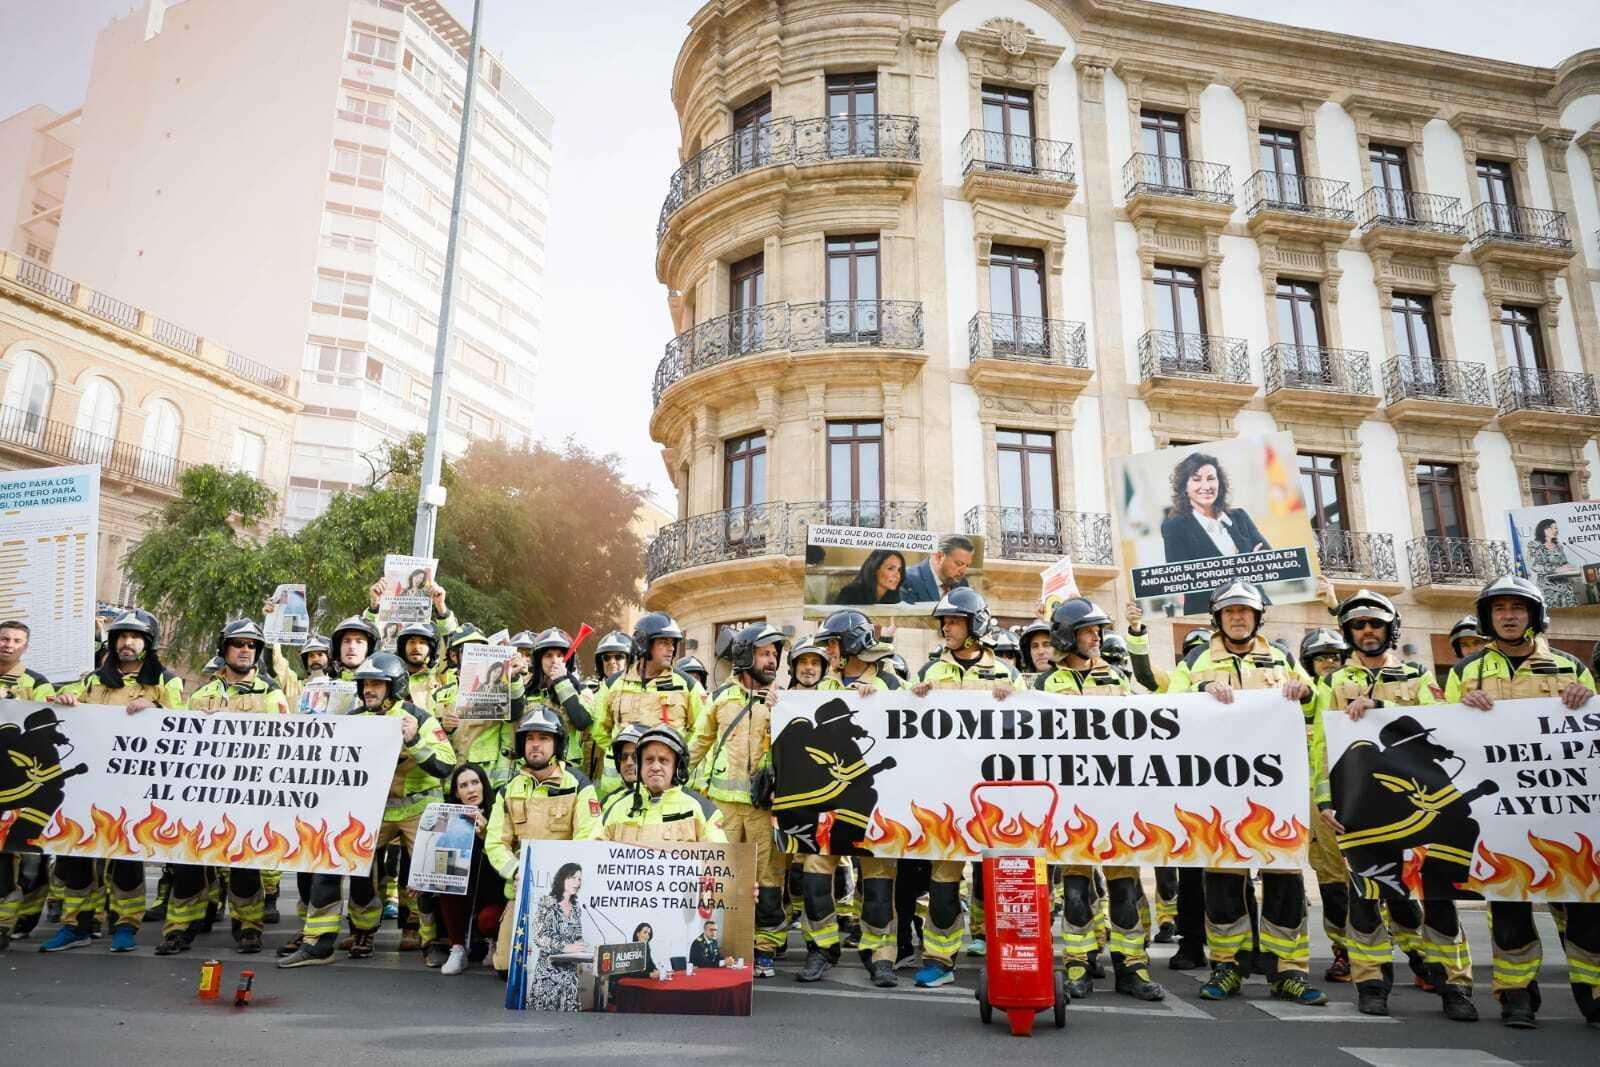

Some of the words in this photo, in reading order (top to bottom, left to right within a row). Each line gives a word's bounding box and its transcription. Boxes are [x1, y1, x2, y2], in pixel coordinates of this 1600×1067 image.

[24, 488, 50, 498] PERO
[52, 486, 77, 495] PARA
[29, 479, 54, 488] PARA
[56, 477, 74, 486] LOS
[14, 499, 39, 508] TOMA
[41, 495, 82, 505] MORENO
[886, 530, 906, 540] DIGO
[906, 542, 934, 550] LORCA
[1150, 565, 1182, 576] MEJOR
[1184, 560, 1220, 572] SUELDO
[1222, 558, 1236, 567] DE
[1237, 552, 1282, 565] ALCALDÍA
[1284, 550, 1297, 558] EN
[1141, 574, 1195, 587] ANDALUCÍA,
[1196, 568, 1235, 580] PORQUE
[1236, 566, 1250, 574] YO
[1251, 564, 1264, 573] LO
[1164, 584, 1188, 594] PERO
[1190, 581, 1210, 590] LOS
[1265, 572, 1280, 580] NO
[160, 716, 210, 734] SIN
[212, 718, 337, 739] INVERSIÓN
[886, 708, 1180, 741] BOMBEROS
[1538, 713, 1600, 734] LAS
[112, 735, 148, 753] NO
[154, 738, 188, 756] SE
[193, 740, 271, 760] PUEDE
[276, 744, 324, 762] DAR
[330, 746, 362, 764] UN
[1483, 742, 1552, 763] DEL
[106, 758, 226, 781] SERVICIO
[232, 764, 264, 783] DE
[269, 766, 370, 788] CALIDAD
[980, 753, 1284, 788] QUEMADOS
[1516, 768, 1587, 788] SON
[144, 783, 176, 801] AL
[182, 785, 320, 809] CIUDADANO
[609, 848, 655, 860] VAMOS
[658, 850, 667, 860] A
[671, 850, 725, 861] CONTAR
[597, 864, 665, 876] MENTIRAS
[606, 880, 652, 892] VAMOS
[656, 882, 665, 892] A
[670, 882, 724, 894] CONTAR
[590, 896, 658, 908] MENTIRAS
